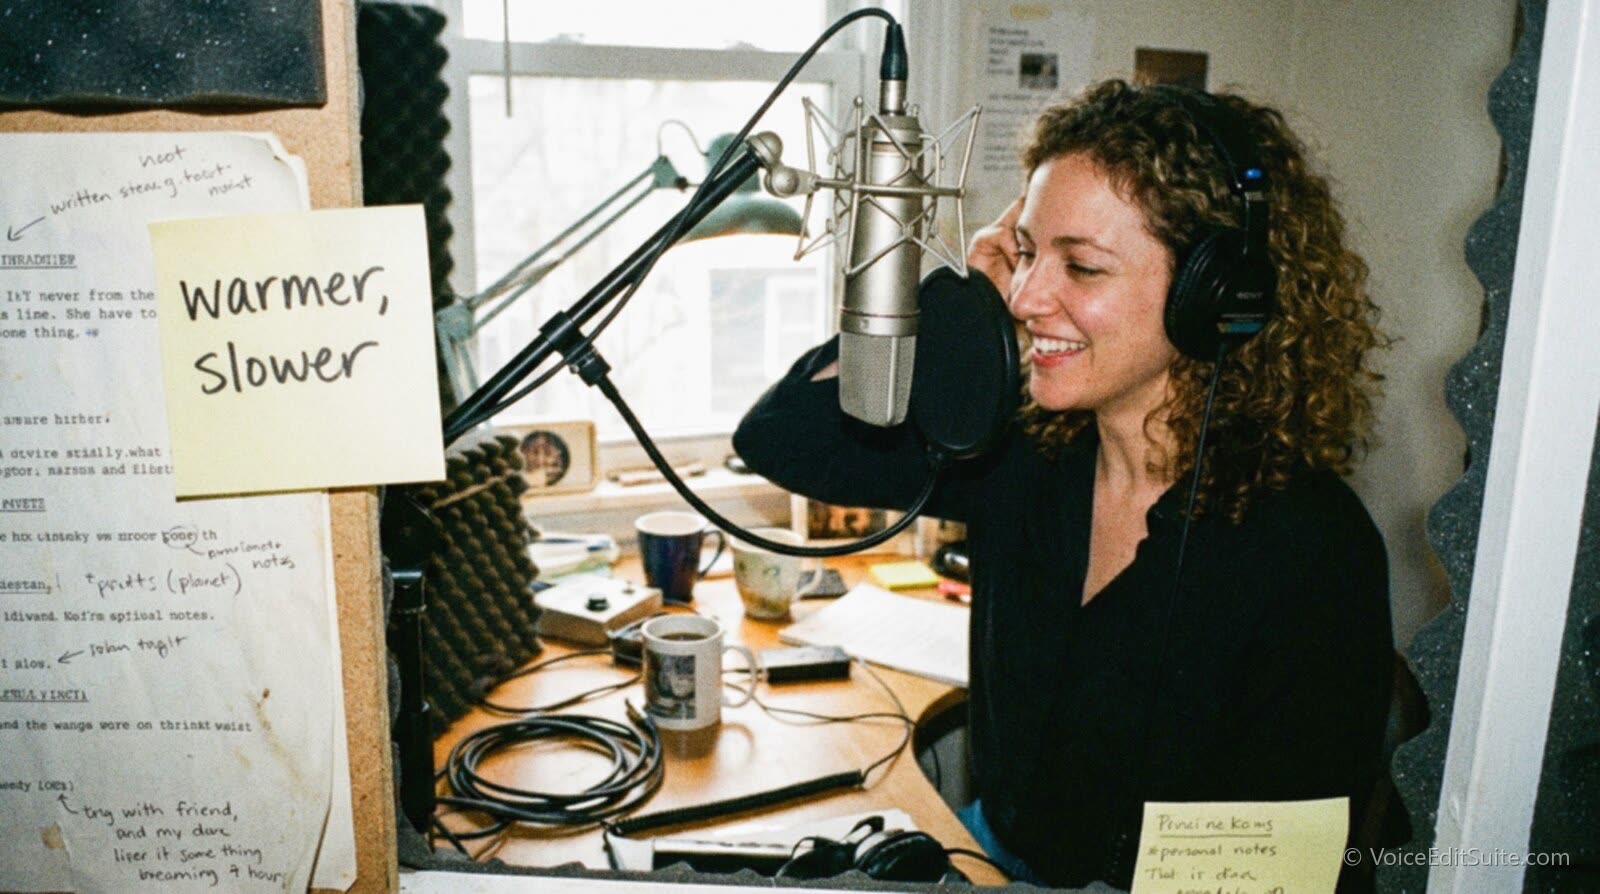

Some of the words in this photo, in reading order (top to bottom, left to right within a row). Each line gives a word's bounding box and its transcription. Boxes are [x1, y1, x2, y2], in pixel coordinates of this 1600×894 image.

[50, 190, 111, 215] written
[39, 291, 80, 302] never
[89, 288, 123, 301] from
[130, 288, 155, 301] the
[179, 266, 389, 321] warmer,
[66, 308, 91, 320] She
[99, 307, 133, 319] have
[140, 308, 157, 319] to
[194, 341, 379, 395] slower
[102, 463, 125, 475] and
[170, 610, 214, 622] notes.
[26, 719, 47, 731] the
[137, 721, 153, 731] on
[123, 803, 164, 819] with
[176, 801, 238, 822] friend,
[116, 826, 146, 840] and
[156, 828, 182, 840] my
[157, 846, 169, 861] it
[222, 844, 262, 865] thing
[1233, 845, 1277, 857] notes
